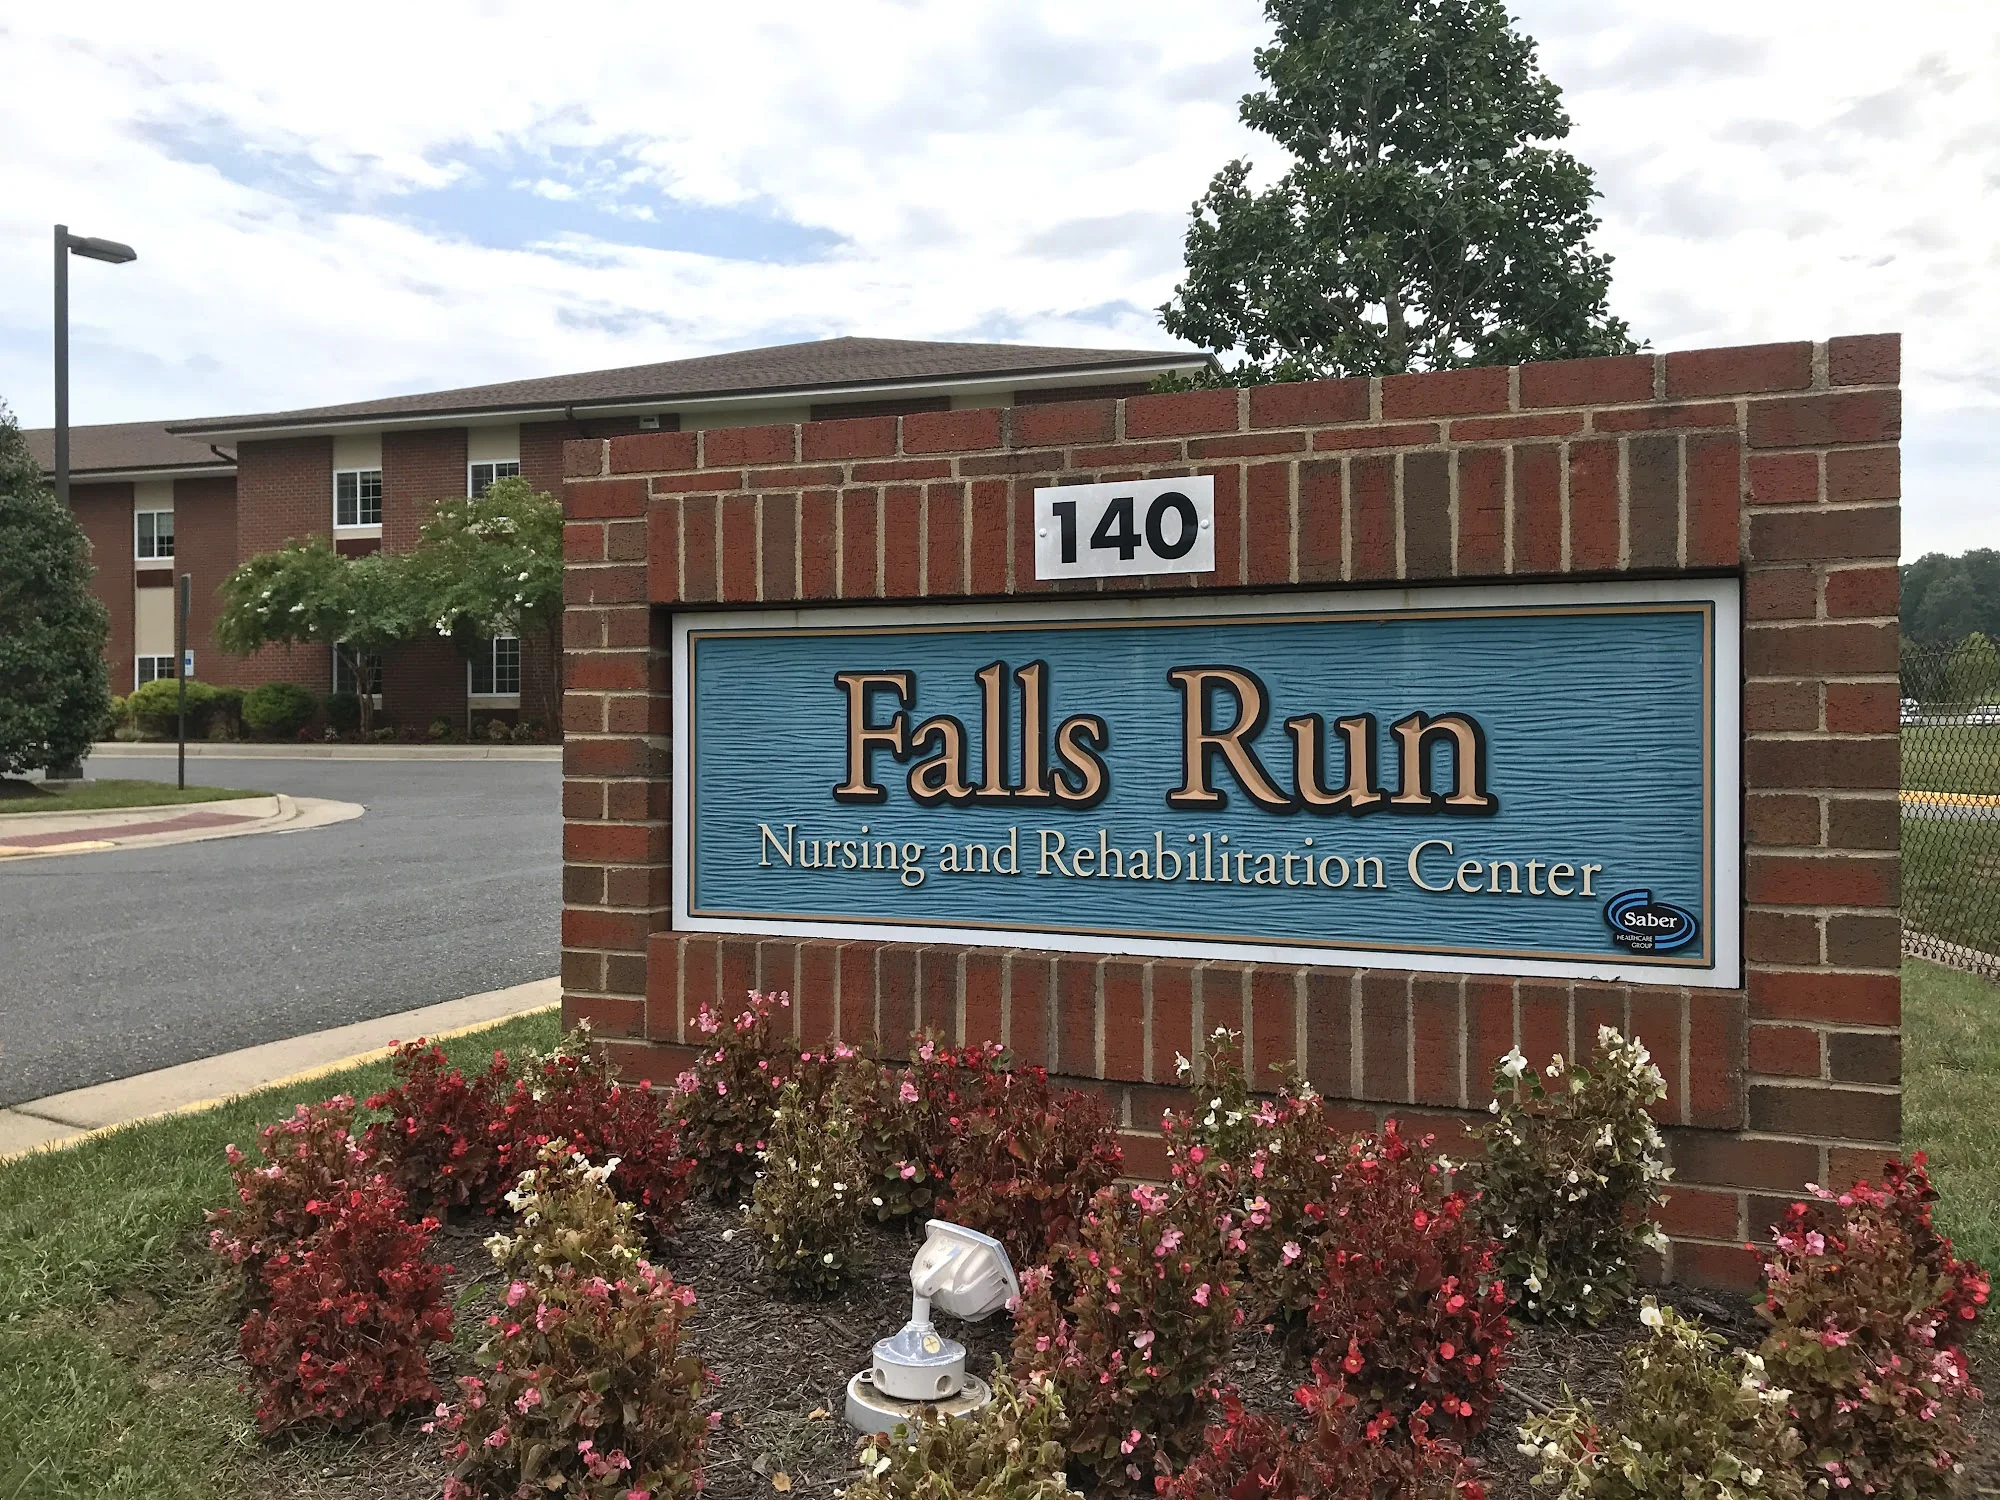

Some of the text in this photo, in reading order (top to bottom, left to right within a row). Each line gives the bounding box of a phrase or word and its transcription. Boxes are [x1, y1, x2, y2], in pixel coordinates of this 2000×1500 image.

[1052, 491, 1199, 564] 140
[834, 660, 1494, 814] Falls Run
[757, 823, 1603, 897] Nursing and Rehabilitation Center
[1616, 934, 1653, 943] HEALTHCARE
[1624, 912, 1678, 928] Saber
